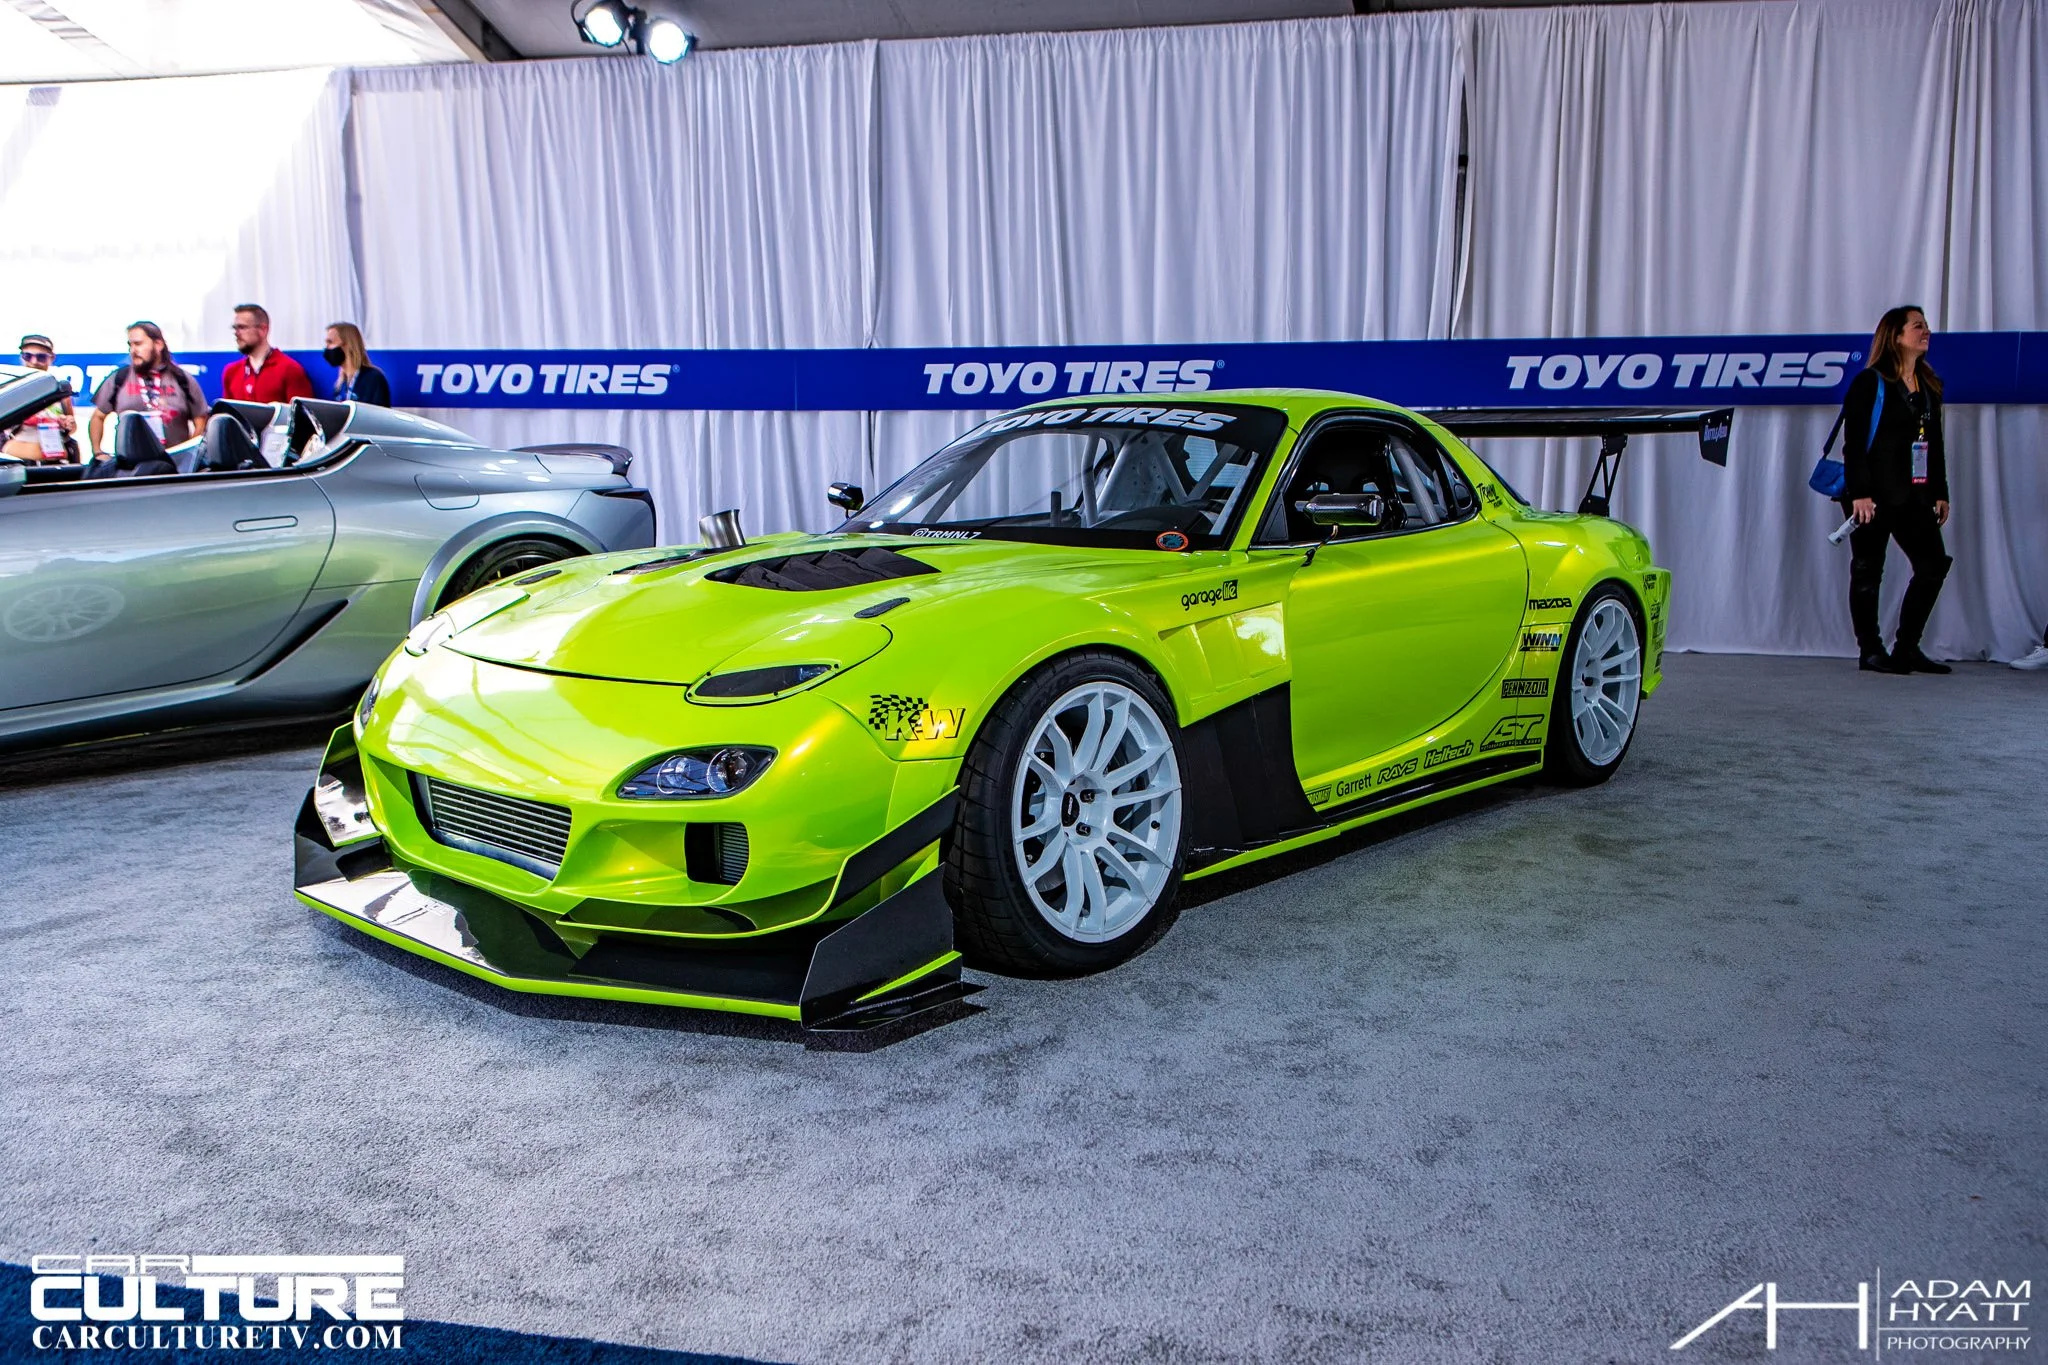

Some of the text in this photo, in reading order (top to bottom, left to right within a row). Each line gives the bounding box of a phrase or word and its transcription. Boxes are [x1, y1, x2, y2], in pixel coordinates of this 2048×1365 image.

[416, 364, 672, 395] TOYO TIRES
[923, 361, 1057, 395] TOYO
[1506, 353, 1664, 389] TOYO
[970, 407, 1238, 437] TOYO TIRES
[1522, 632, 1563, 647] WINN
[1502, 680, 1548, 697] PENNZOIL
[1336, 774, 1372, 797] Garrett
[1377, 758, 1419, 785] RAYS
[1424, 740, 1474, 769] Haltech
